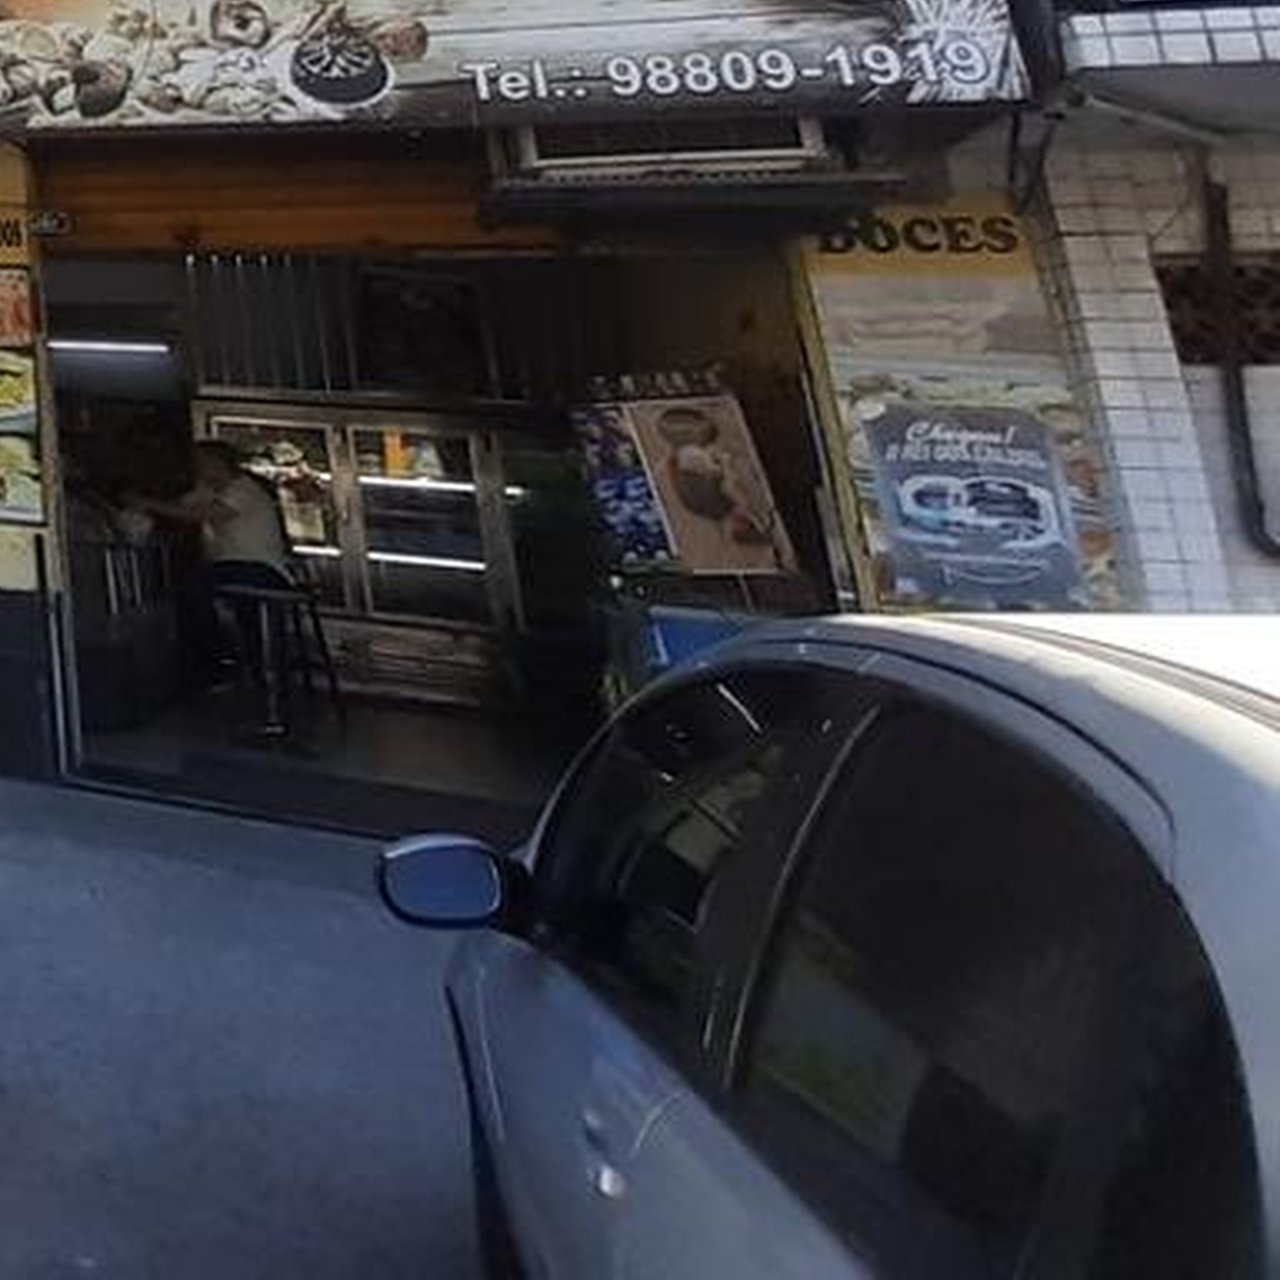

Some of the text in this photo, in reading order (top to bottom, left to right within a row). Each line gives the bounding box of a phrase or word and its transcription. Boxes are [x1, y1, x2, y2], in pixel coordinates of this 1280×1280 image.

[461, 41, 988, 102] Tel.: 98809-1919
[819, 215, 1019, 254] DOCES
